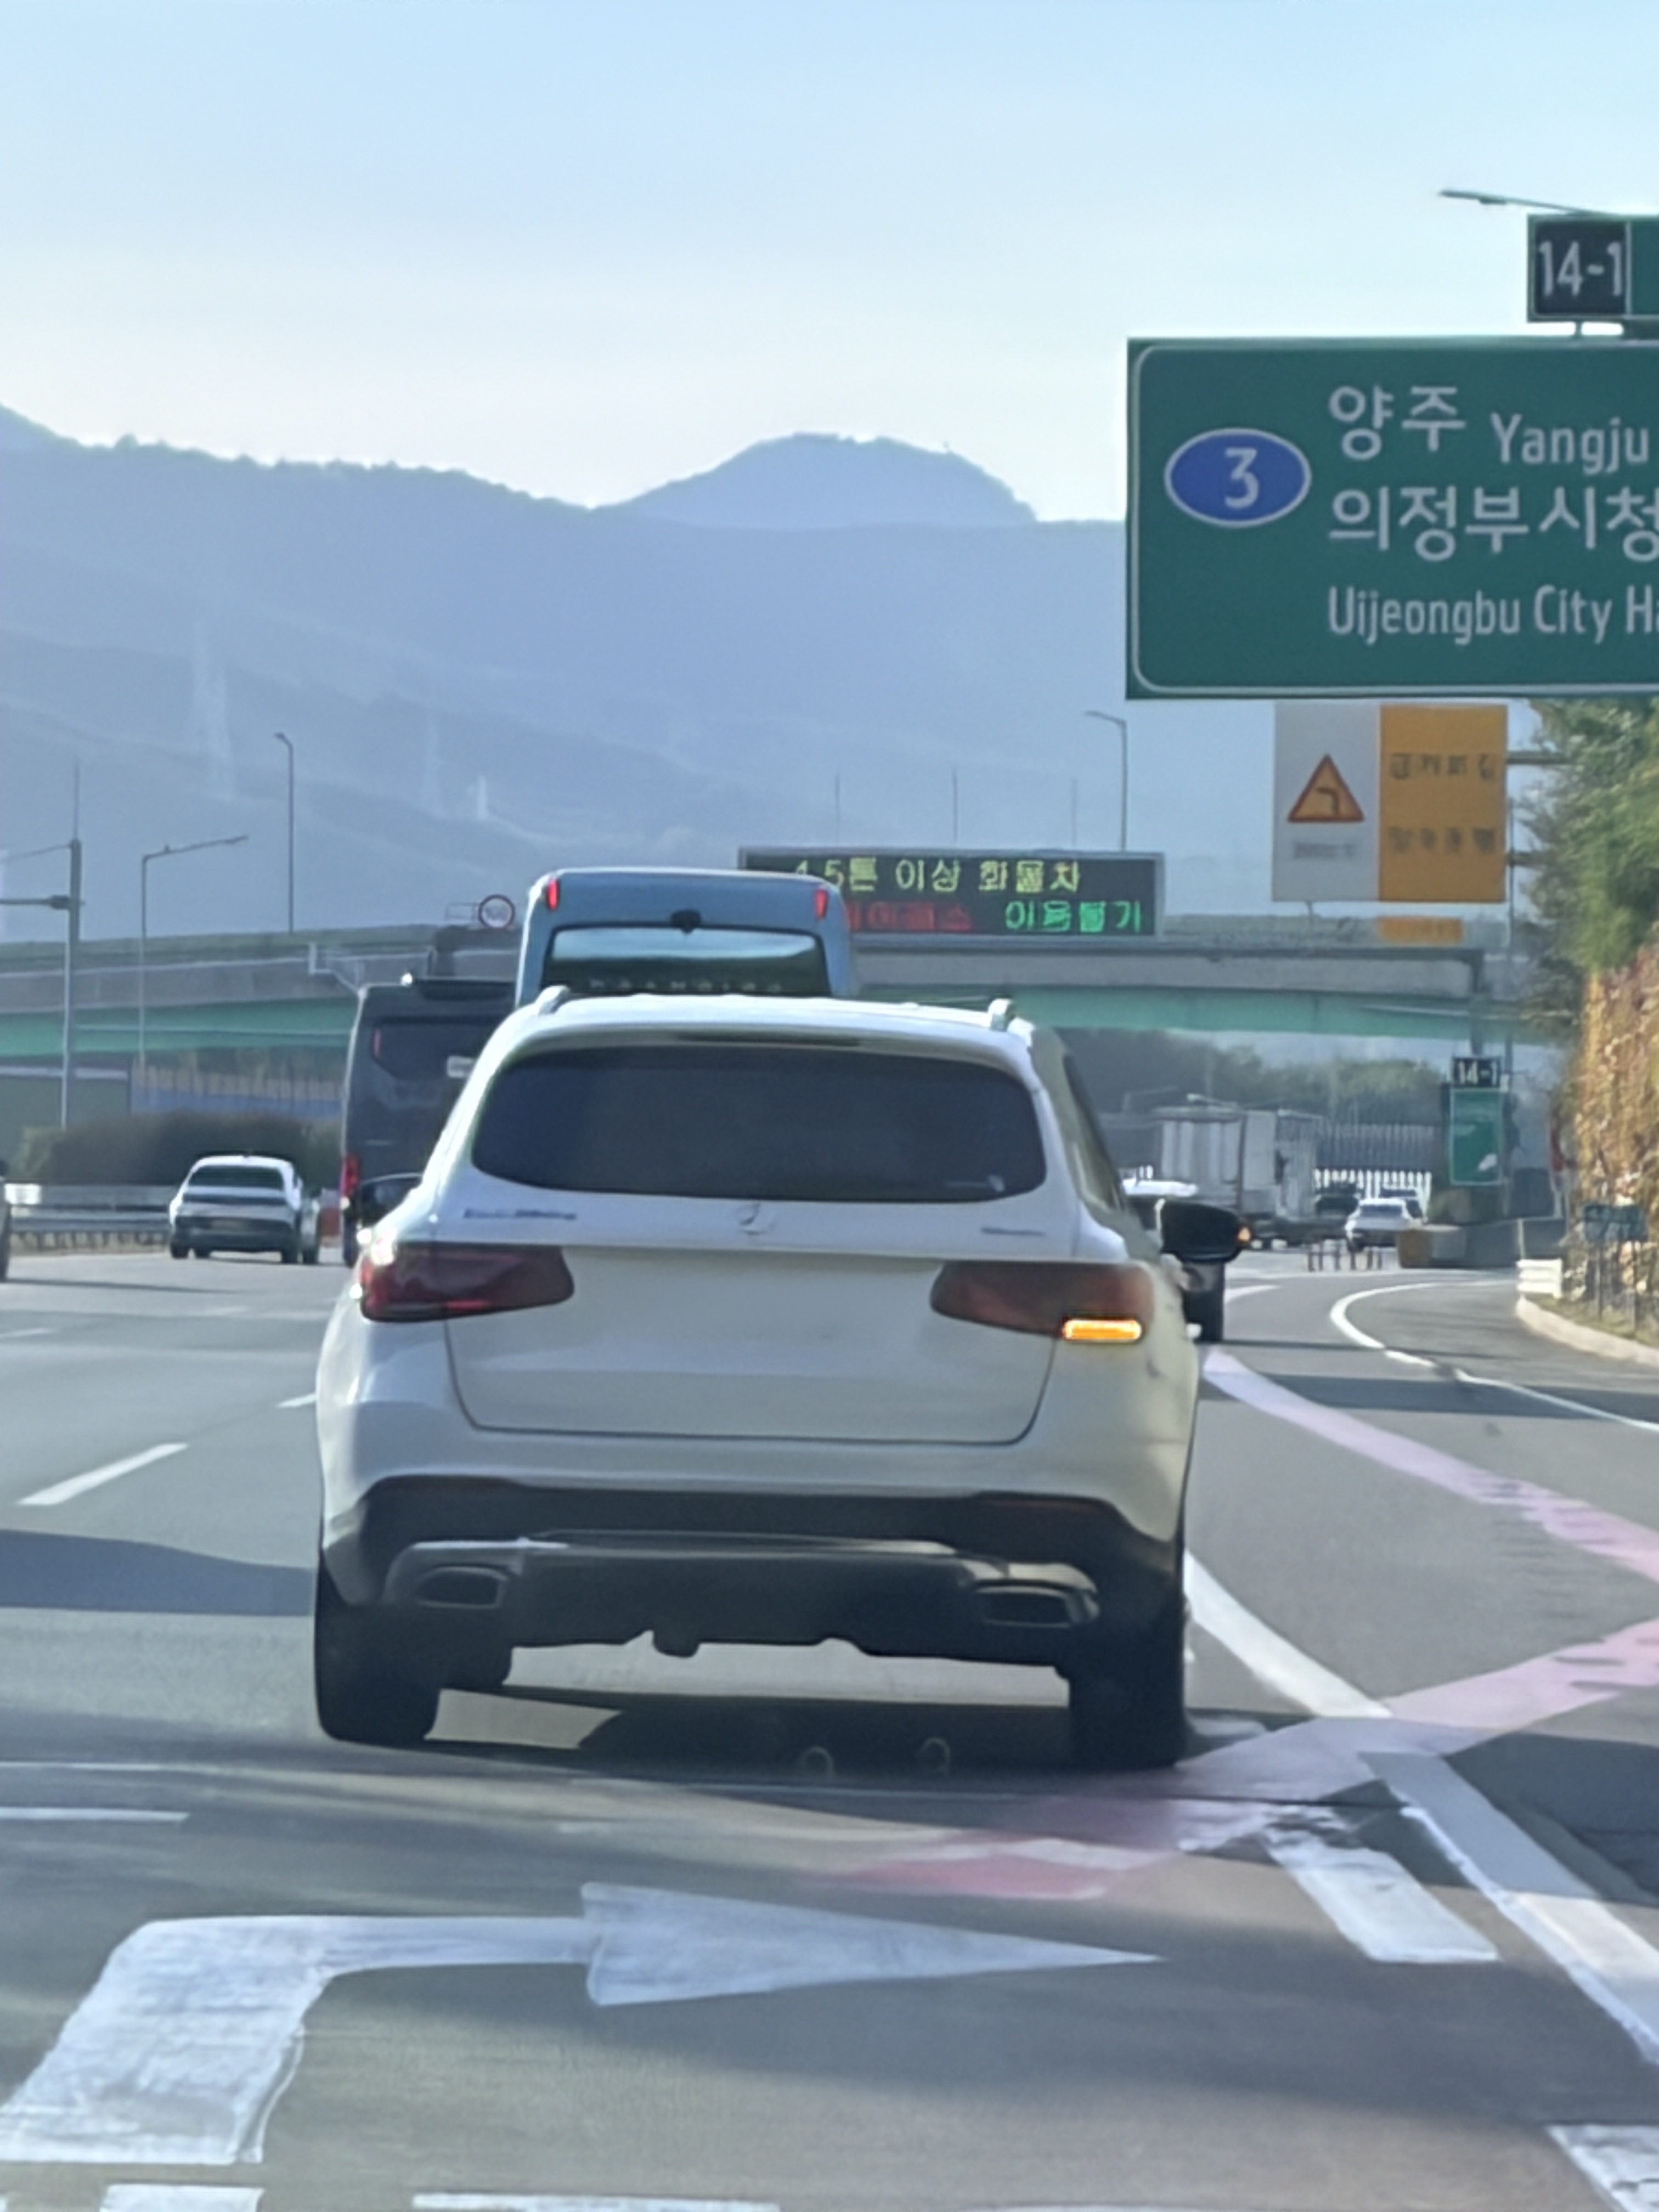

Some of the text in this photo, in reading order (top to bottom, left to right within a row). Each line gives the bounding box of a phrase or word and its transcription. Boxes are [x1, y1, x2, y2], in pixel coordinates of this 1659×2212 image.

[1539, 240, 1623, 297] 14-1
[1329, 385, 1648, 475] 양주 Yangju
[1224, 447, 1260, 509] 3
[1329, 584, 1659, 646] Uijeongbu City H
[895, 859, 962, 892] 이상
[1459, 1061, 1497, 1085] 14-1
